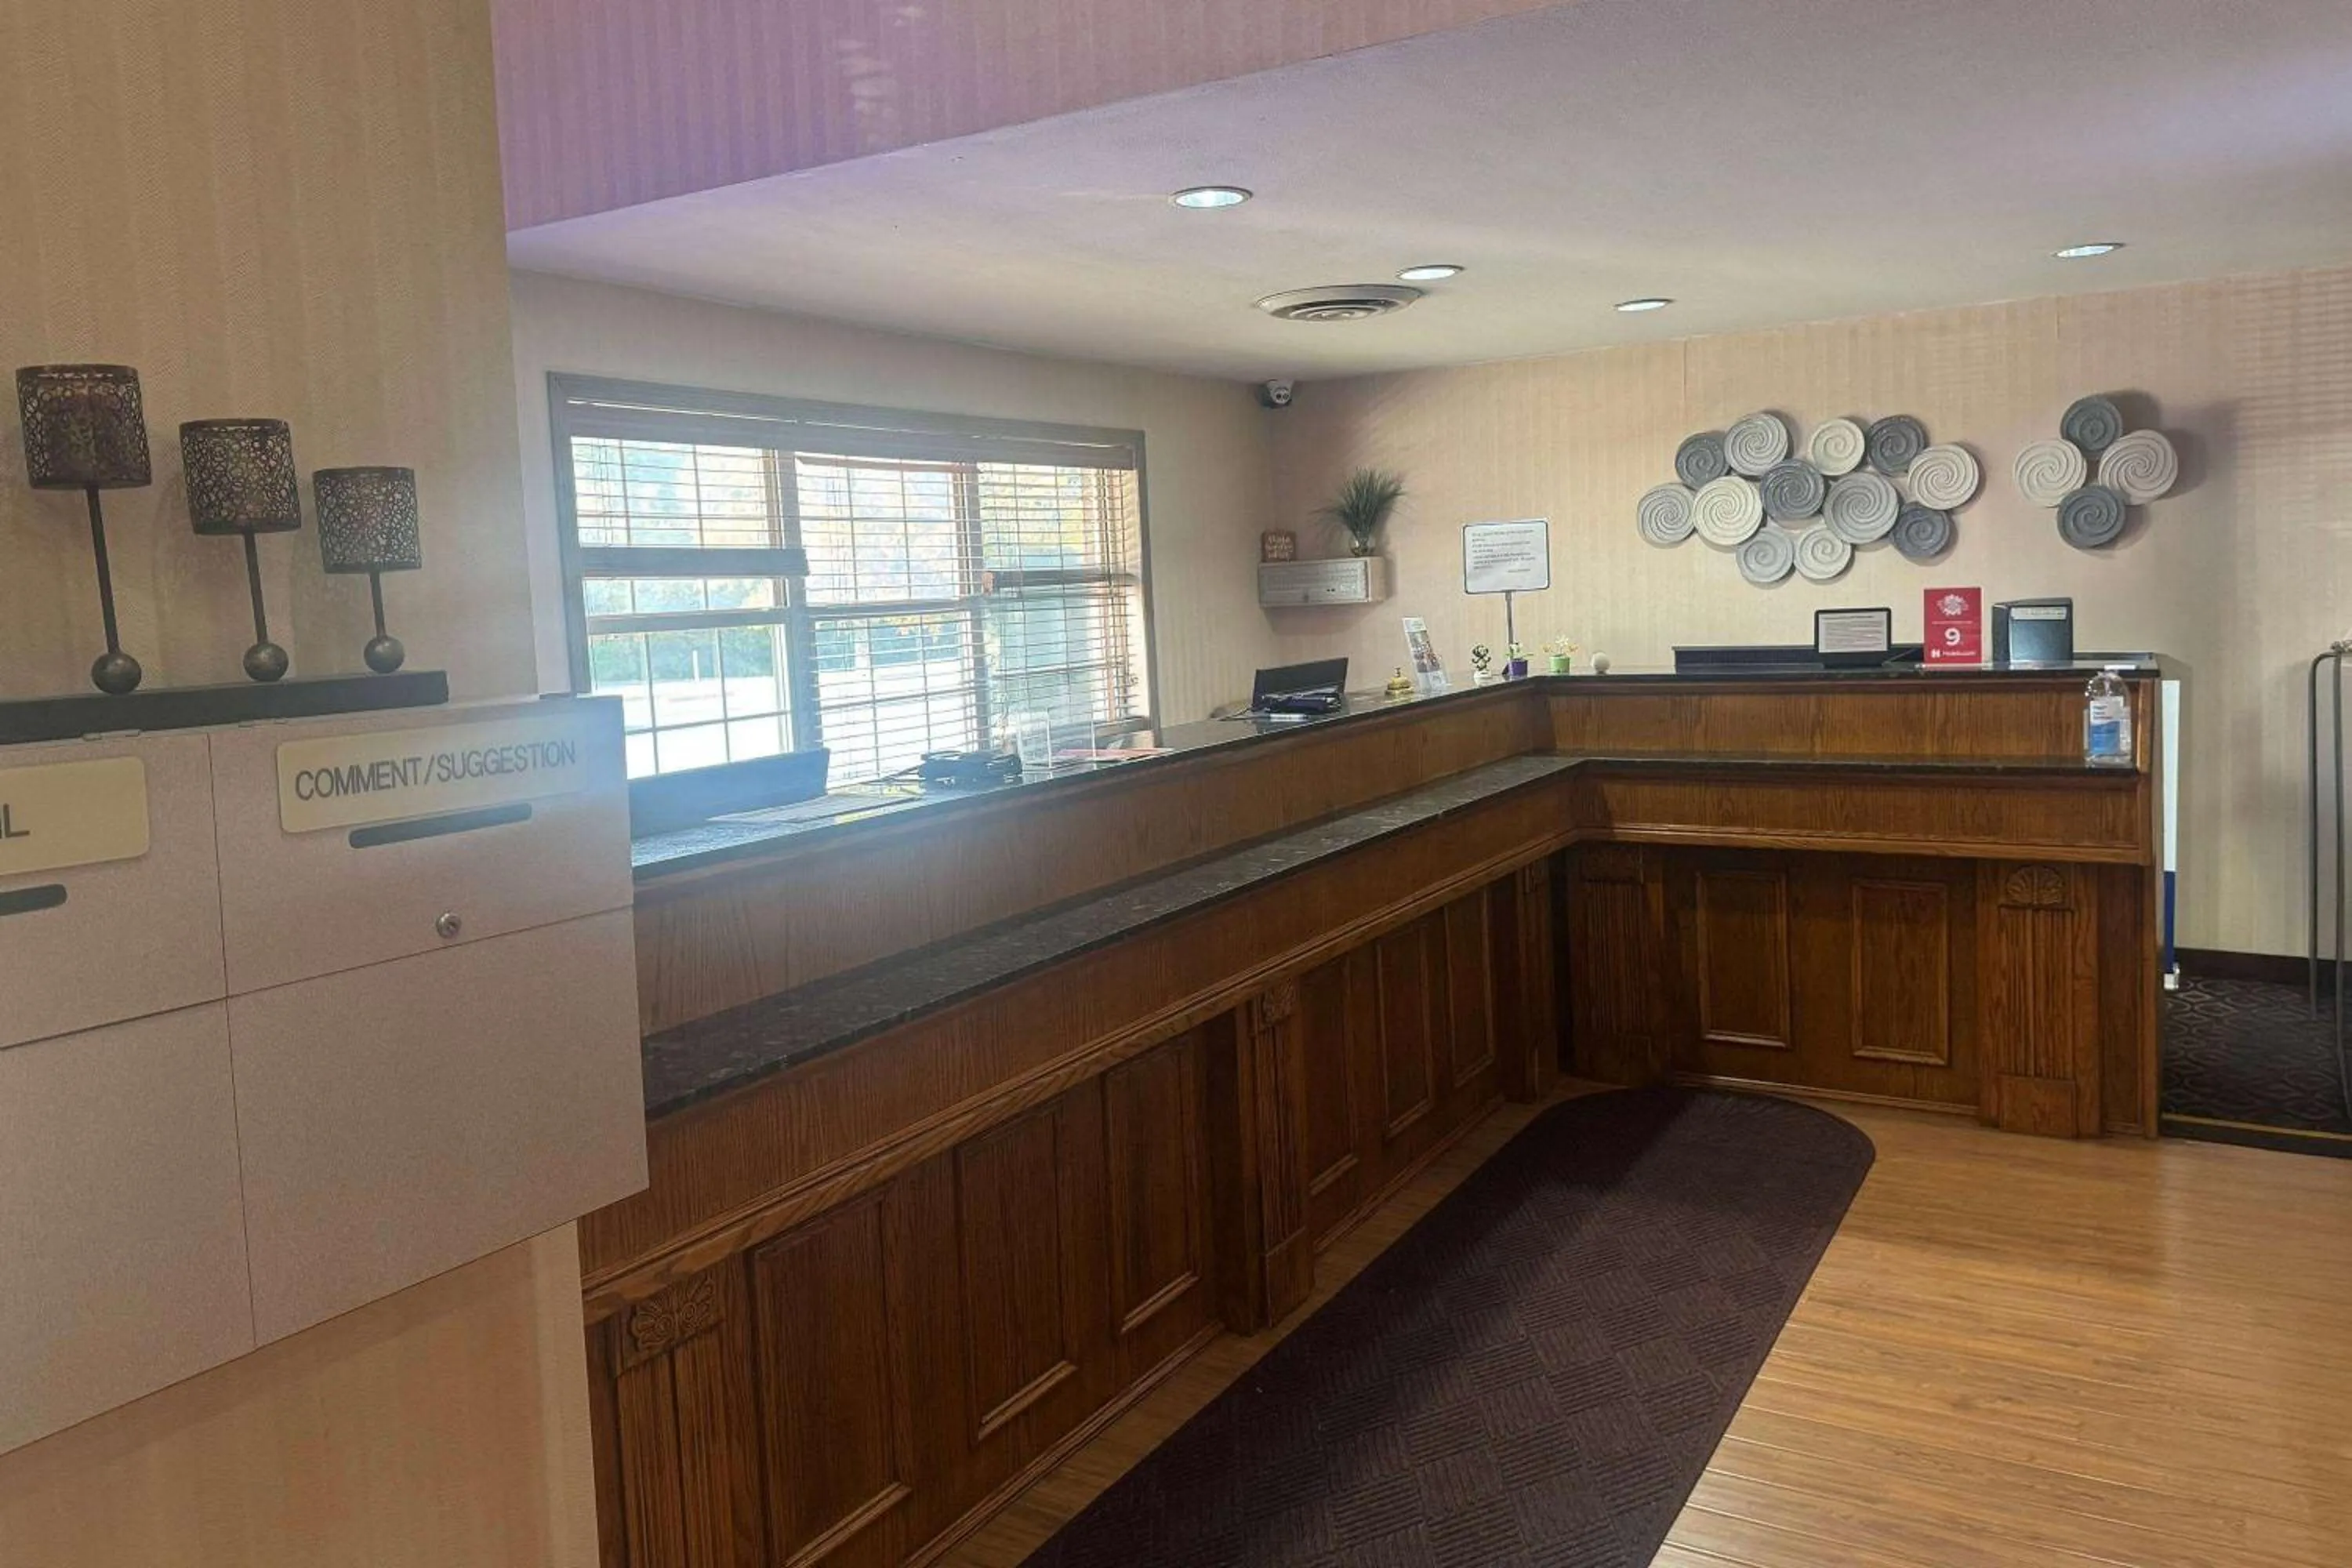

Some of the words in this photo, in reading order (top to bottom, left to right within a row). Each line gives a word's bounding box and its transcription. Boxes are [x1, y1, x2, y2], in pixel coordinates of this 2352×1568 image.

[1944, 627, 1961, 646] 9
[295, 740, 576, 801] COMMENT/SUGGESTION
[0, 803, 31, 839] L
